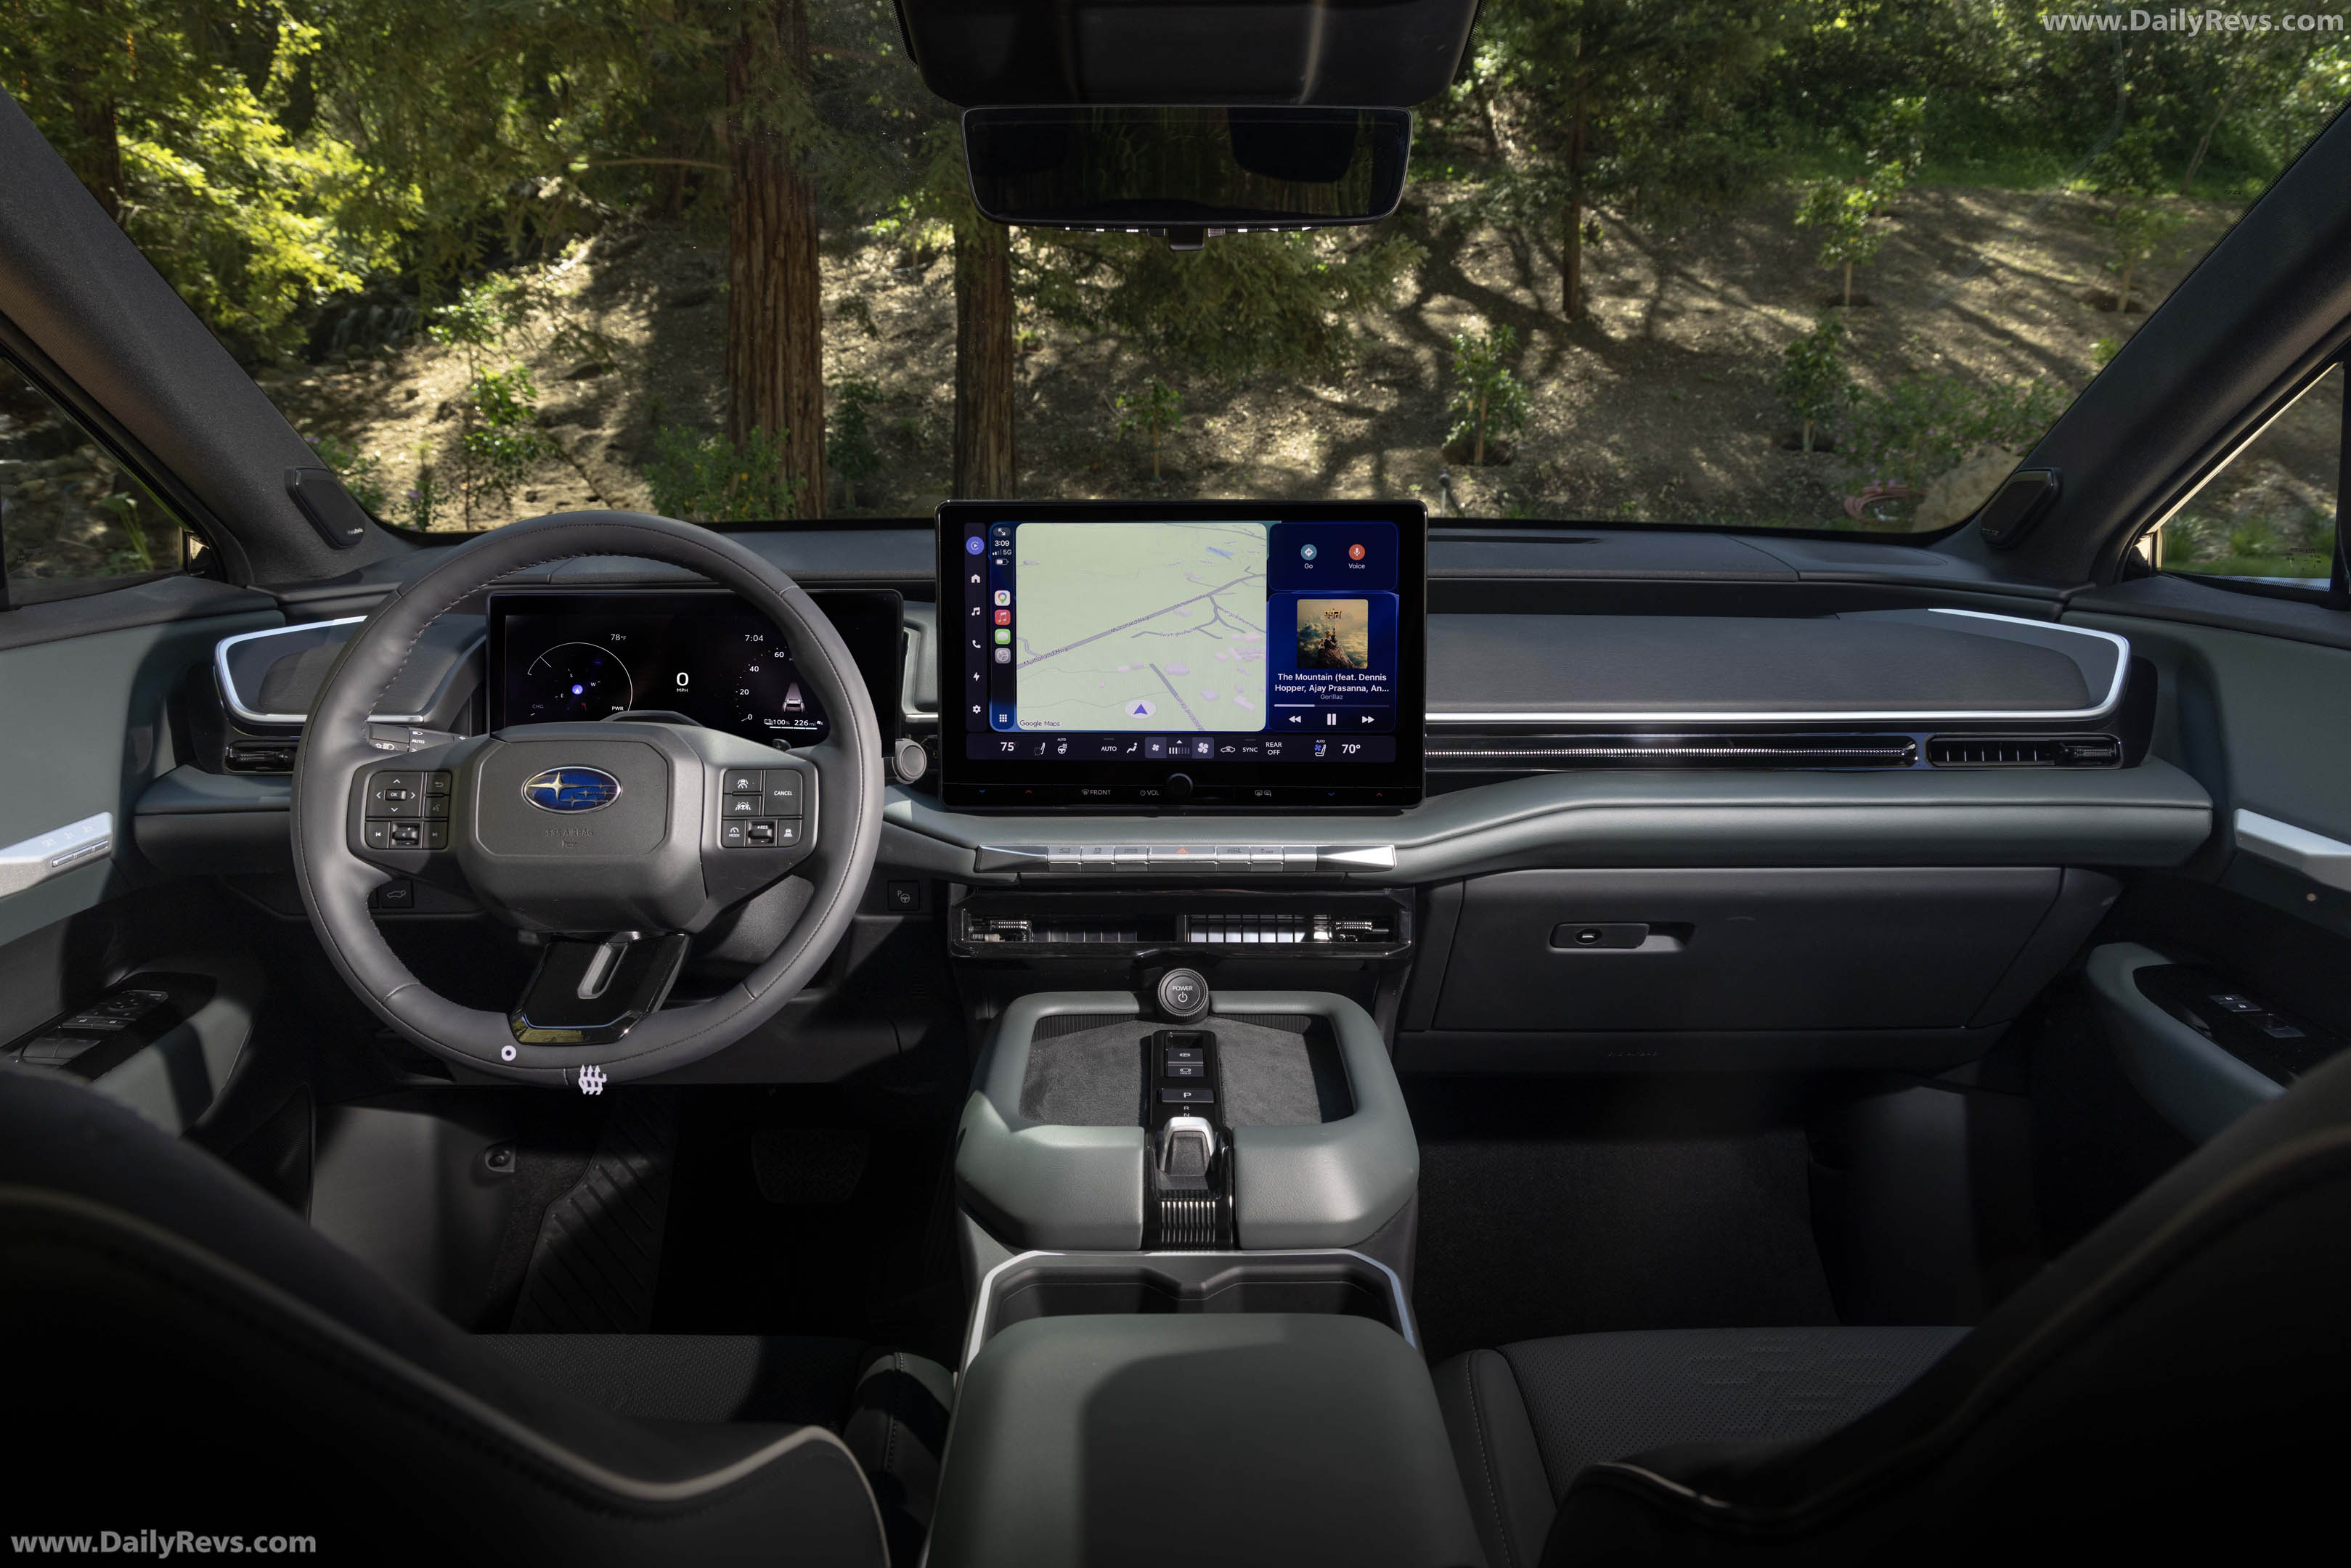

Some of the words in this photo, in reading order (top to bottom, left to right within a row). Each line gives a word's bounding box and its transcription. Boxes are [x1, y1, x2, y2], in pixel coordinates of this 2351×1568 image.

[676, 671, 689, 687] 0
[1335, 673, 1357, 682] (feat.
[1274, 684, 1307, 693] Hopper,
[1308, 684, 1327, 693] Ajay
[1328, 684, 1369, 693] Prasanna,
[1018, 719, 1043, 729] Google
[1341, 743, 1361, 754] 70°
